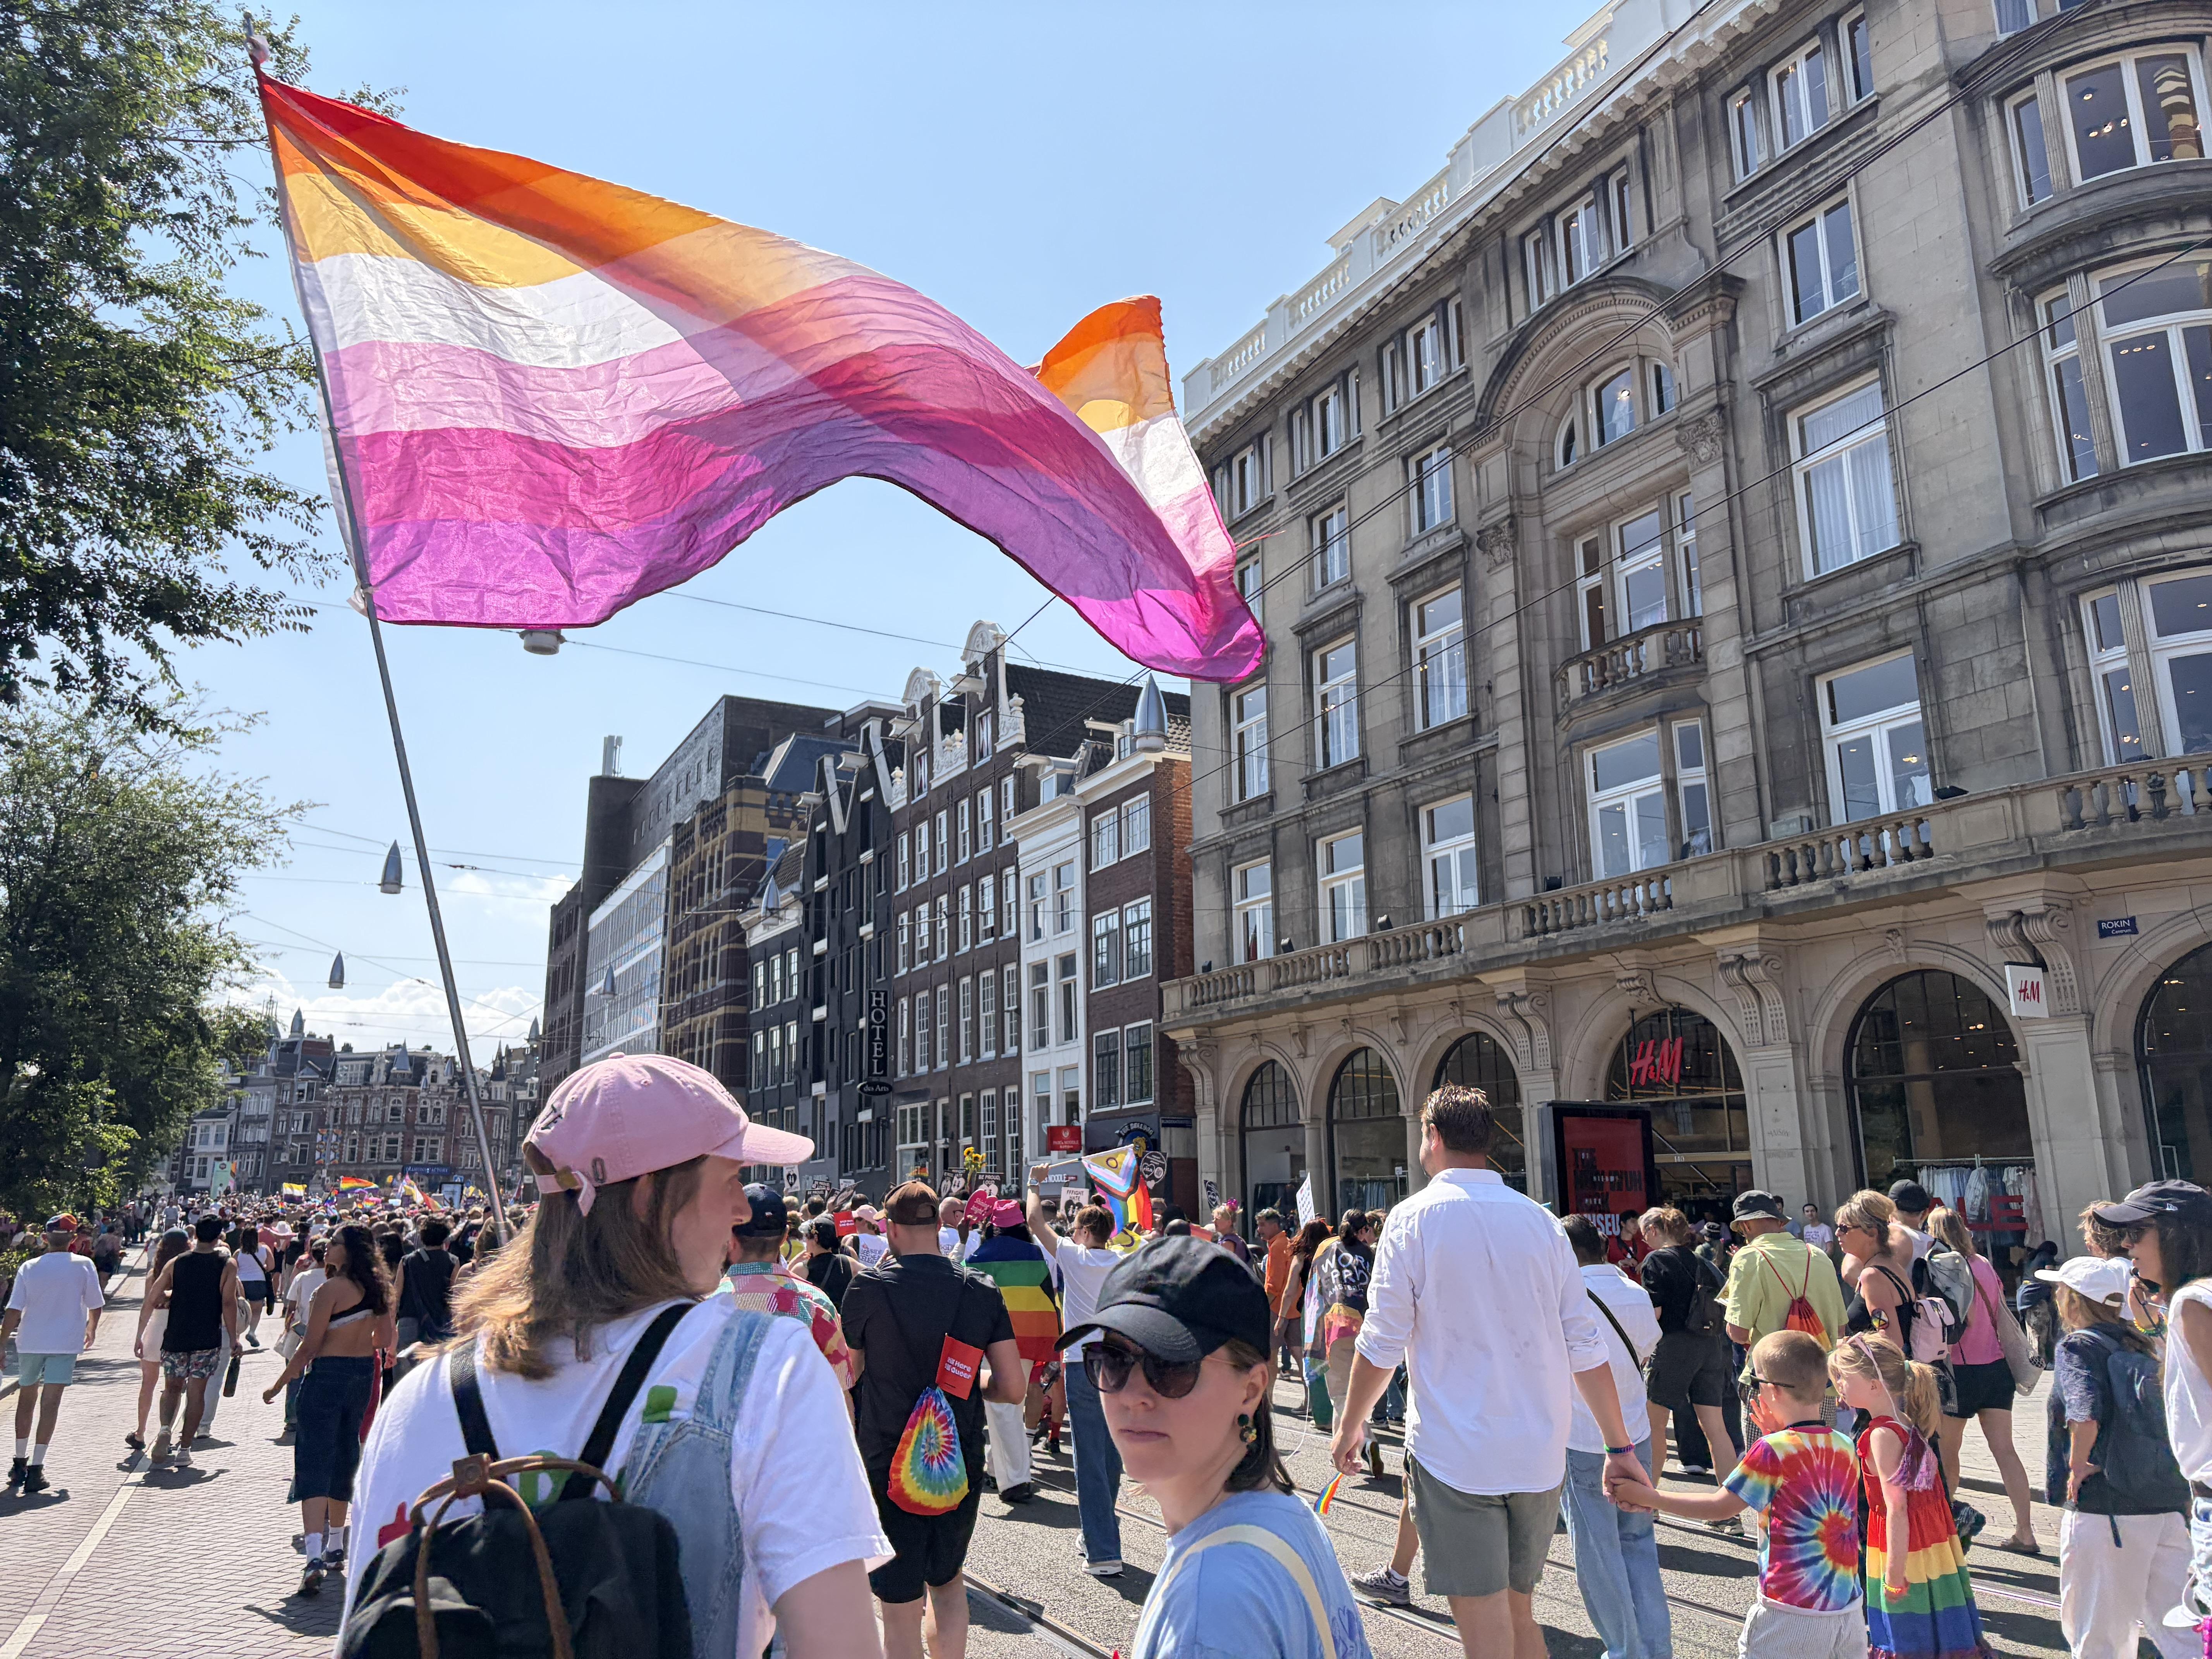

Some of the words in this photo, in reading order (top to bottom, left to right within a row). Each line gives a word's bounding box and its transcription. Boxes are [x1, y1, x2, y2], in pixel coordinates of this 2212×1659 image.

[2102, 919, 2131, 929] ROKIN
[2018, 980, 2040, 1004] H&M
[871, 991, 886, 1075] HOTEL
[1630, 1036, 1683, 1086] H&M
[1048, 1174, 1068, 1182] NOODLE
[955, 1360, 972, 1372] Here
[951, 1367, 972, 1379] Queer
